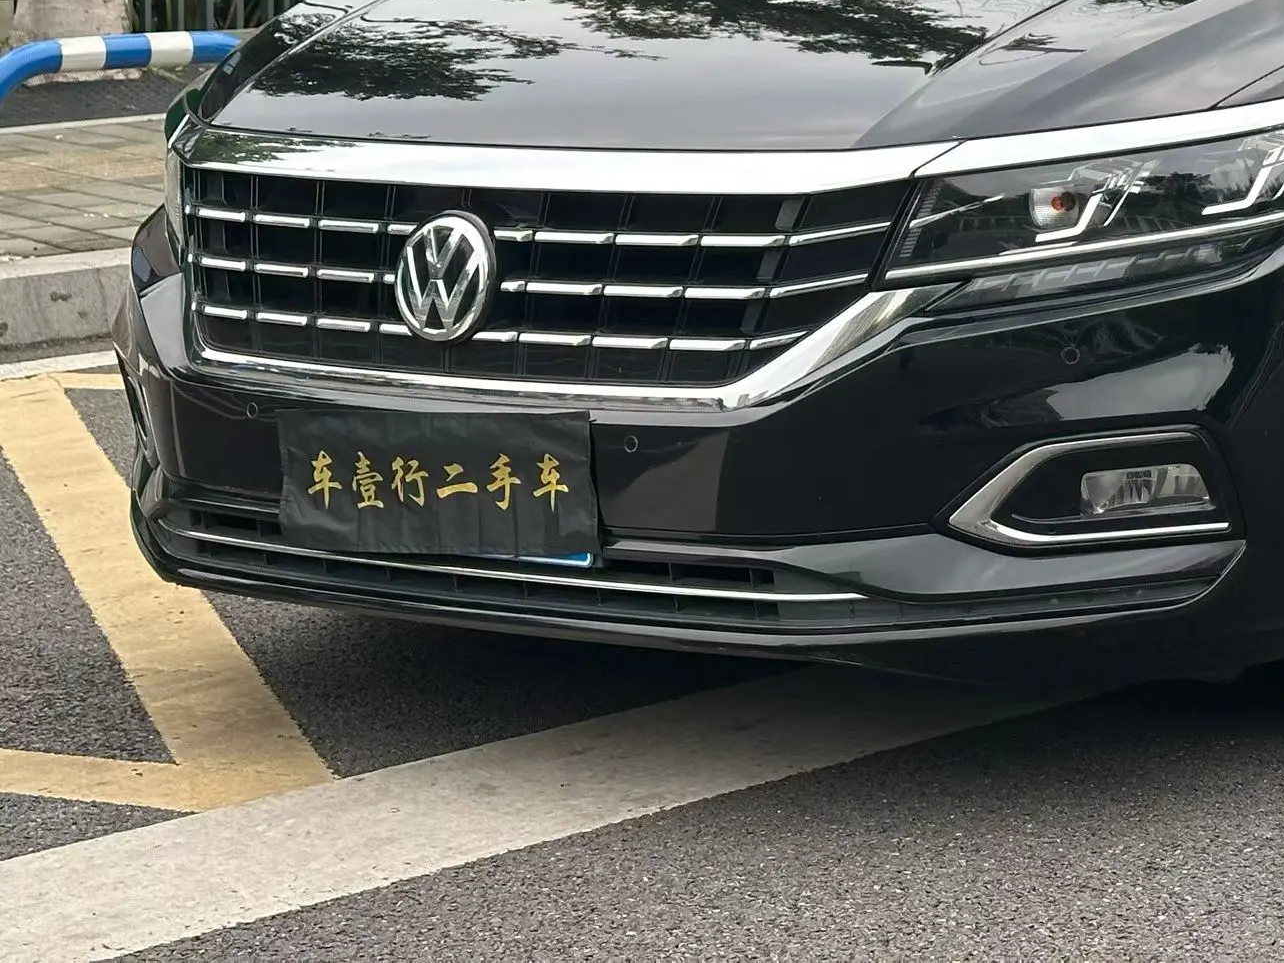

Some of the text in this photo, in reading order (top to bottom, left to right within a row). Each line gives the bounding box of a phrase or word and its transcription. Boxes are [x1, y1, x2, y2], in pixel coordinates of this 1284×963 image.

[308, 450, 569, 512] 车壹行二手车
